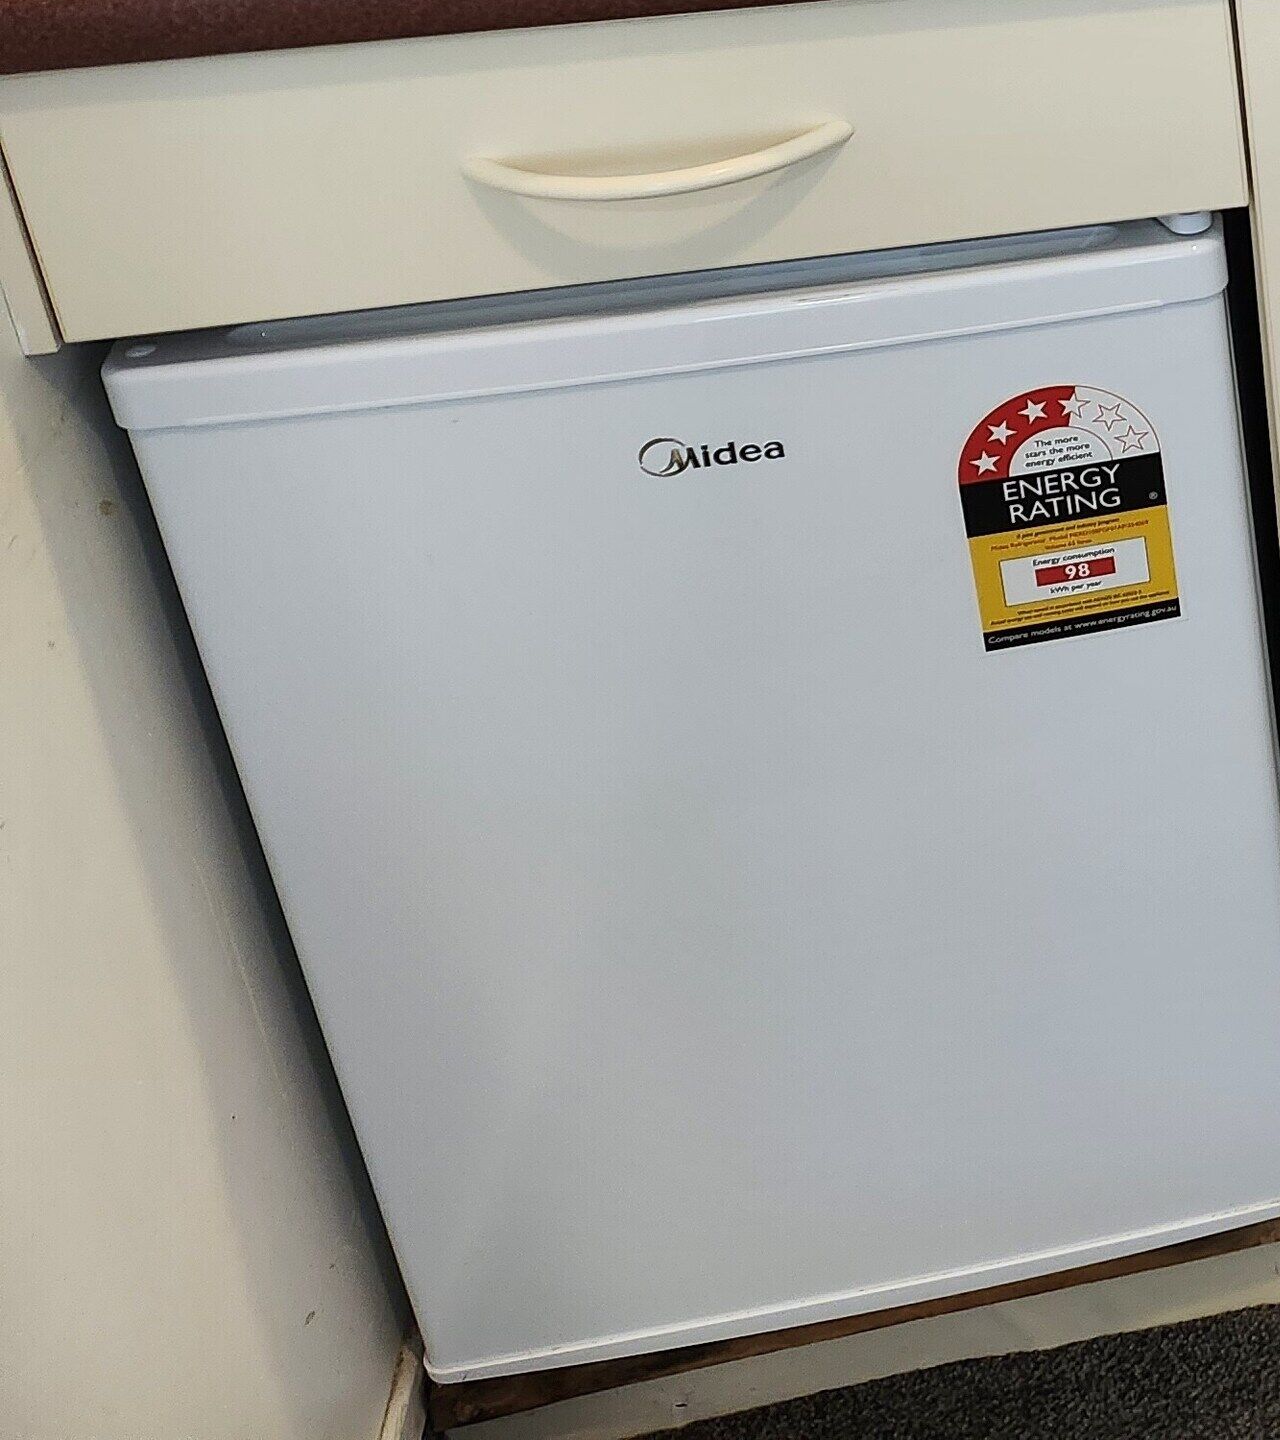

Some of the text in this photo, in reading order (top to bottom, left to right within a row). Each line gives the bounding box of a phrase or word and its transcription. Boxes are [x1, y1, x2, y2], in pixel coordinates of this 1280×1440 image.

[1055, 436, 1078, 444] more
[657, 441, 785, 474] Midea
[1025, 450, 1046, 458] stars
[1066, 443, 1090, 451] more
[1025, 451, 1093, 467] energy efficient
[1003, 463, 1120, 501] ENERGY
[1009, 488, 1121, 524] RATING
[1032, 547, 1115, 566] Energy consumption
[1065, 563, 1091, 579] 98
[1050, 580, 1102, 594] kWh per year
[988, 631, 1028, 644] Compare
[1031, 625, 1061, 637] models
[1074, 605, 1177, 630] www.energyrating.gov.au
